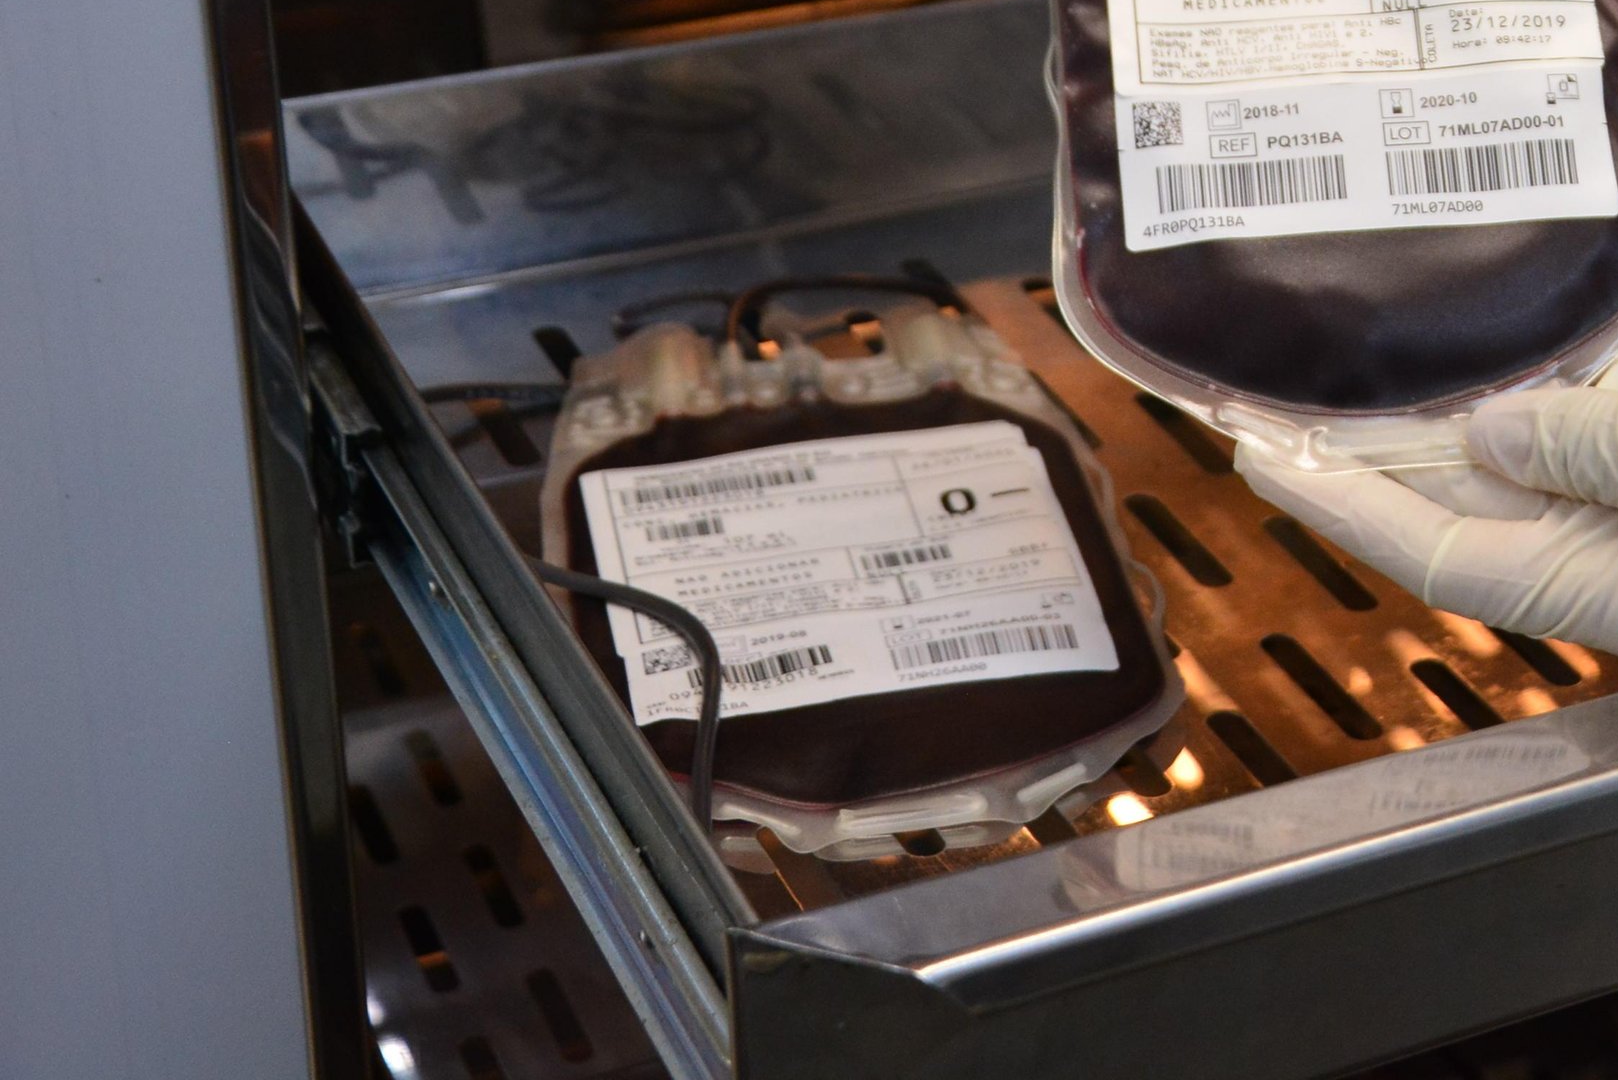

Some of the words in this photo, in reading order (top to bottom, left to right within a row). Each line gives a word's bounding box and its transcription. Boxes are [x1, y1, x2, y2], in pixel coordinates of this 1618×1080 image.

[1449, 7, 1484, 18] Data:
[1451, 15, 1567, 33] 23/12/2019
[1425, 23, 1438, 64] COLETA
[1452, 38, 1488, 50] Hora:
[1420, 91, 1478, 109] 2020-10
[1243, 103, 1299, 120] 2018-11
[1389, 126, 1422, 141] LOT
[1438, 114, 1565, 138] 71ML07AD00-01
[1218, 137, 1250, 153] REF
[1267, 131, 1344, 150] PQ131BA
[1392, 200, 1484, 216] 71ML07AD00
[1143, 215, 1245, 238] 4FR0PQ131BA
